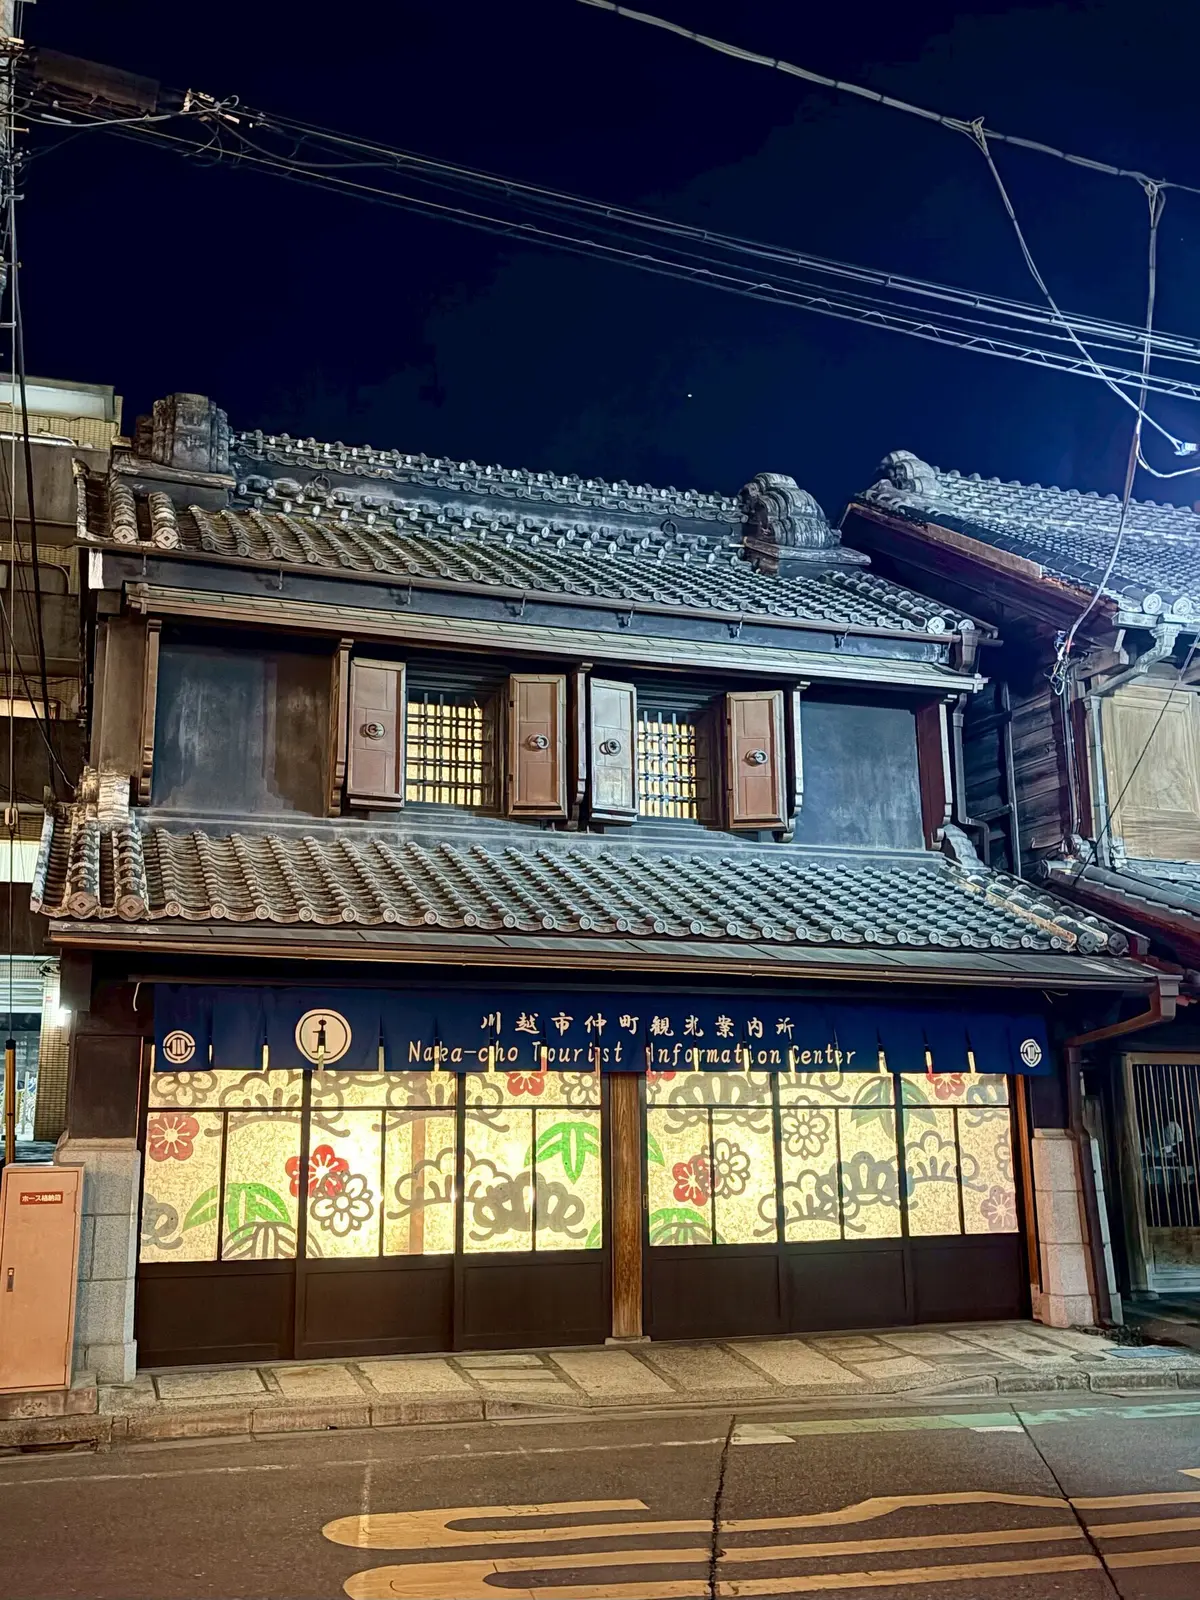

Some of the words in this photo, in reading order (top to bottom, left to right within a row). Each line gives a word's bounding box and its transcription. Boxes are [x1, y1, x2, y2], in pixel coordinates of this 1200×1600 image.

[480, 1011, 796, 1041] 川越市仲町観光案内所
[408, 1040, 519, 1063] Naka-cho
[531, 1041, 623, 1063] Tourist
[648, 1042, 781, 1066] Information
